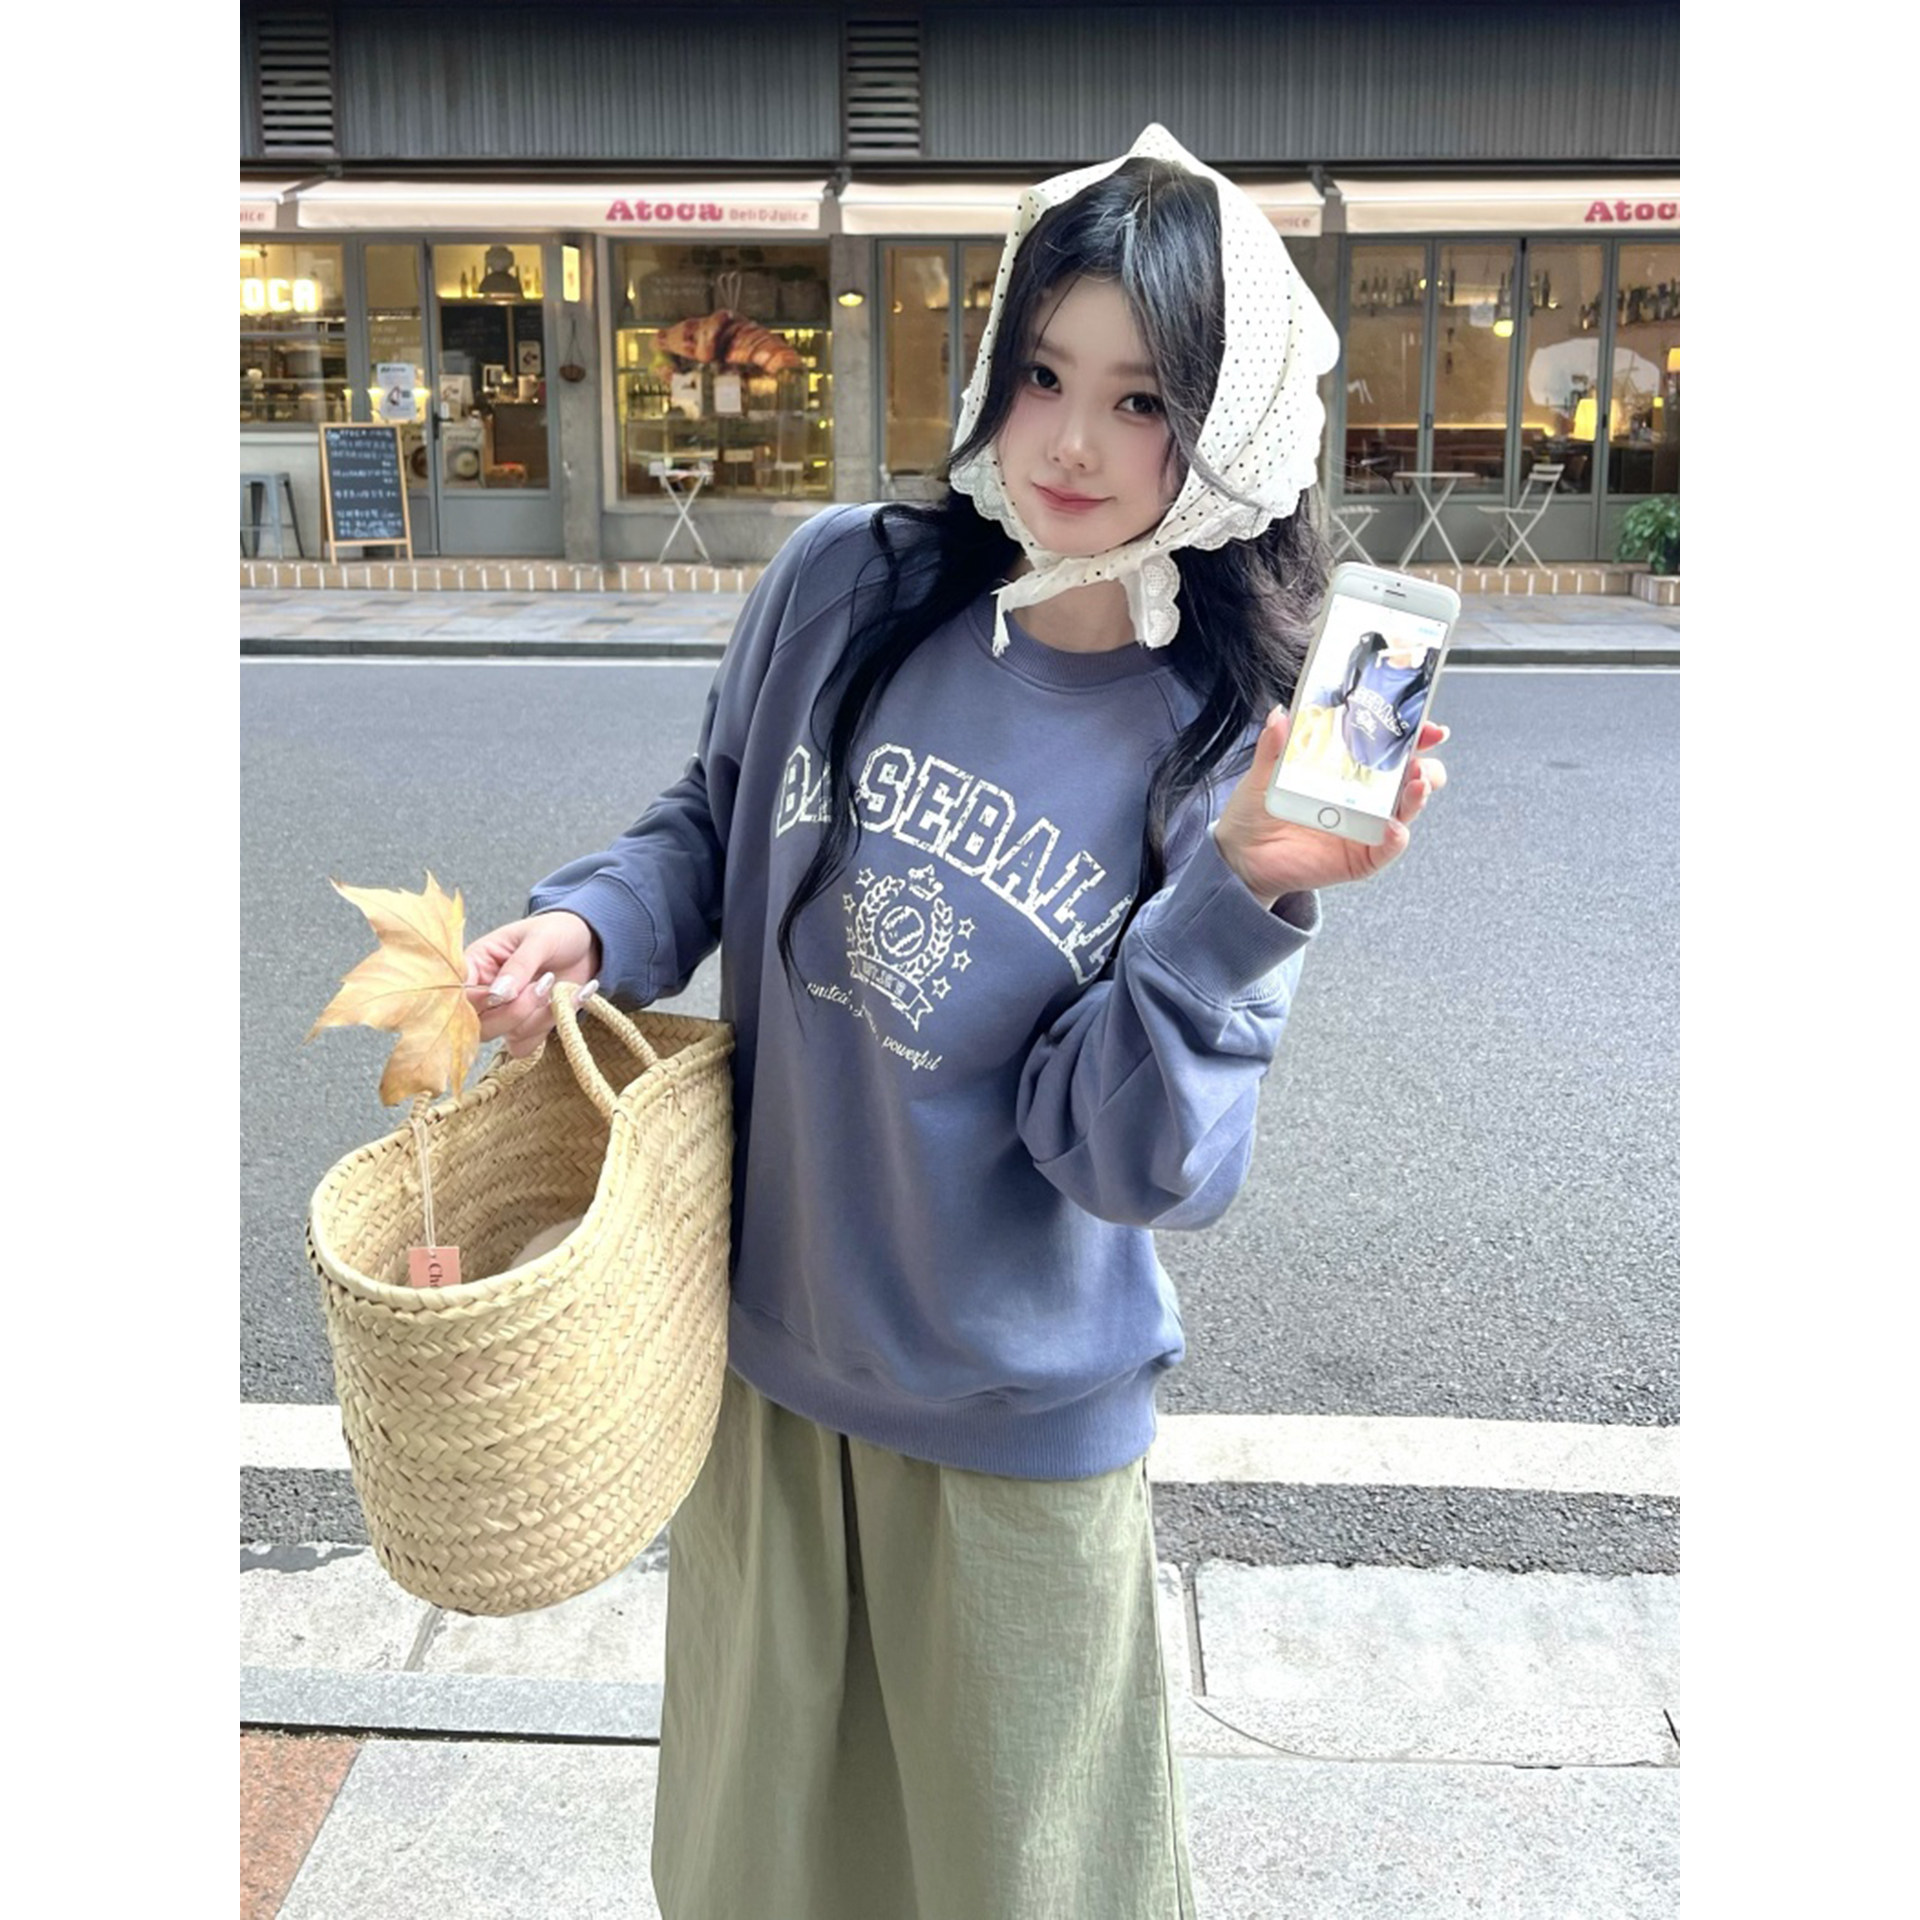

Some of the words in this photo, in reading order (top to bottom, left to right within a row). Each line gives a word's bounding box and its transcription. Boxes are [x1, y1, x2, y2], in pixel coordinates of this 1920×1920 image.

[605, 199, 723, 222] Atoca
[1584, 199, 1680, 223] Atoc
[428, 1263, 443, 1288] Ch
